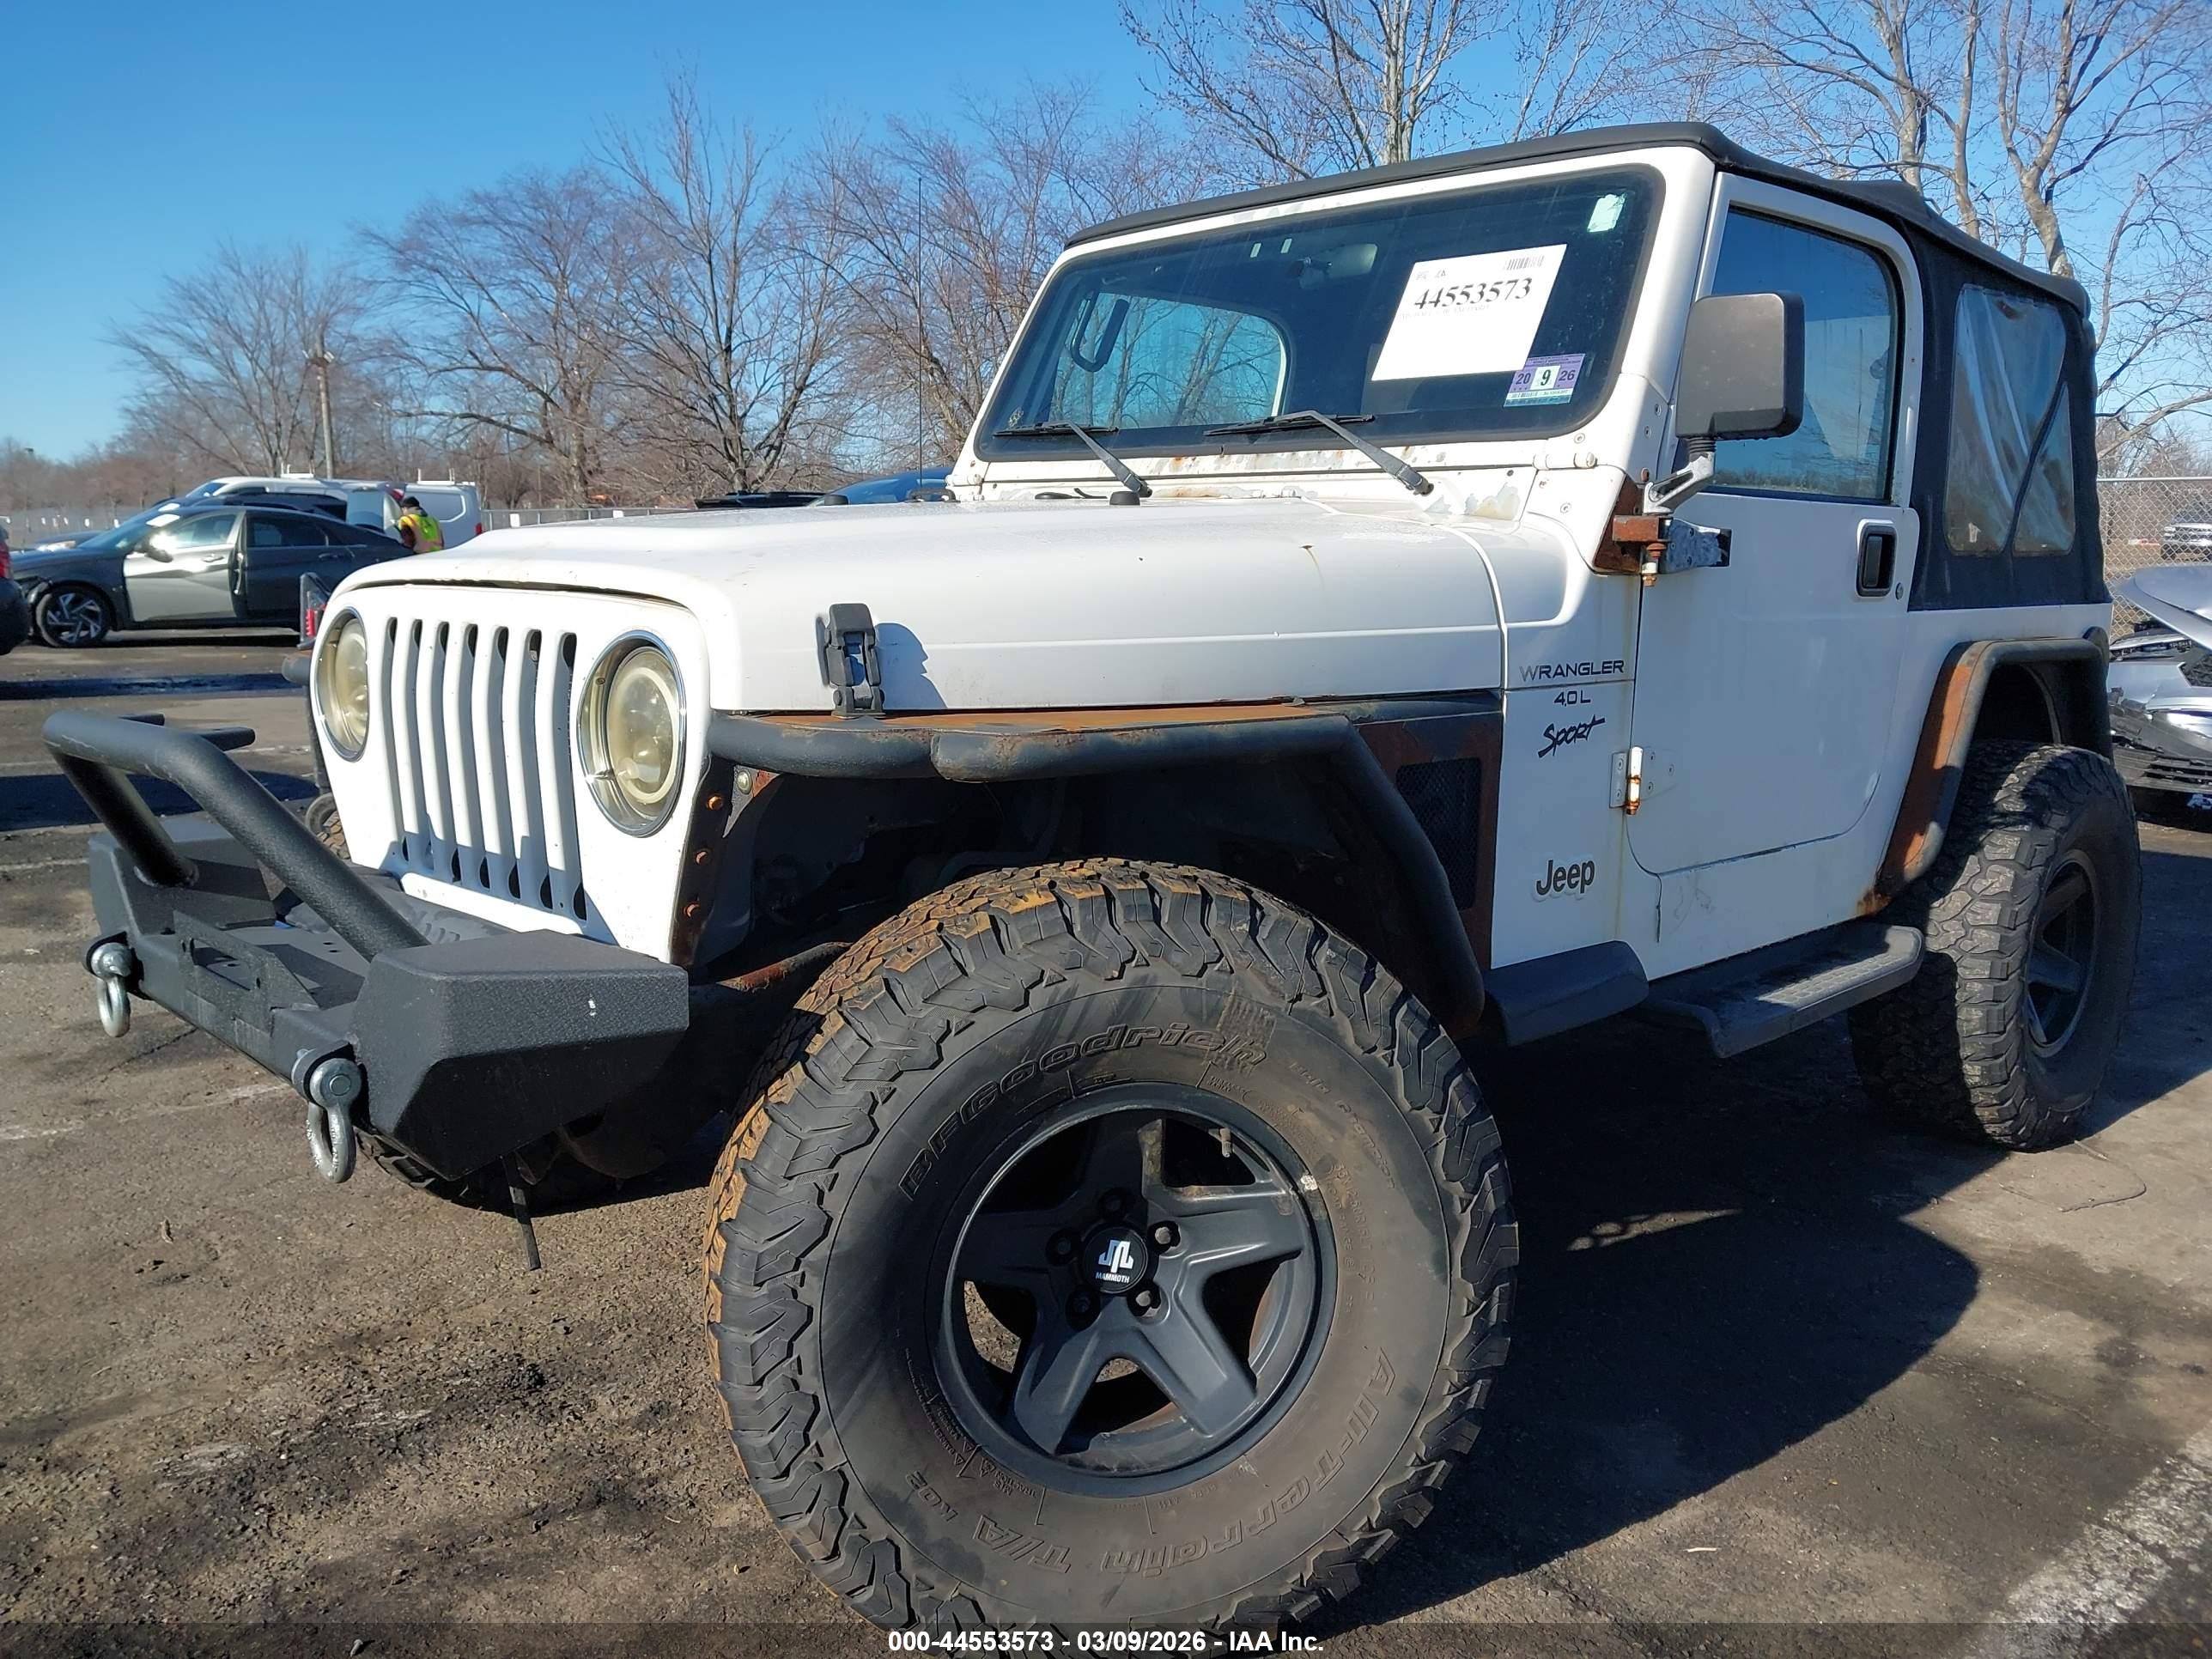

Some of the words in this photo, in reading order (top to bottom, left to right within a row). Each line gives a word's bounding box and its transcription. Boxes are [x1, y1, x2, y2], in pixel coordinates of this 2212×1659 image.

[1414, 276, 1533, 310] 44553573
[1516, 373, 1531, 385] 20
[1540, 369, 1552, 386] 9
[1558, 370, 1576, 381] 26
[1519, 659, 1625, 682] WRANGLER
[1535, 859, 1595, 896] Jeep
[898, 1024, 1267, 1200] BFGoodrich
[1095, 1272, 1130, 1284] MAMMOTH
[972, 1514, 1072, 1574] T/A
